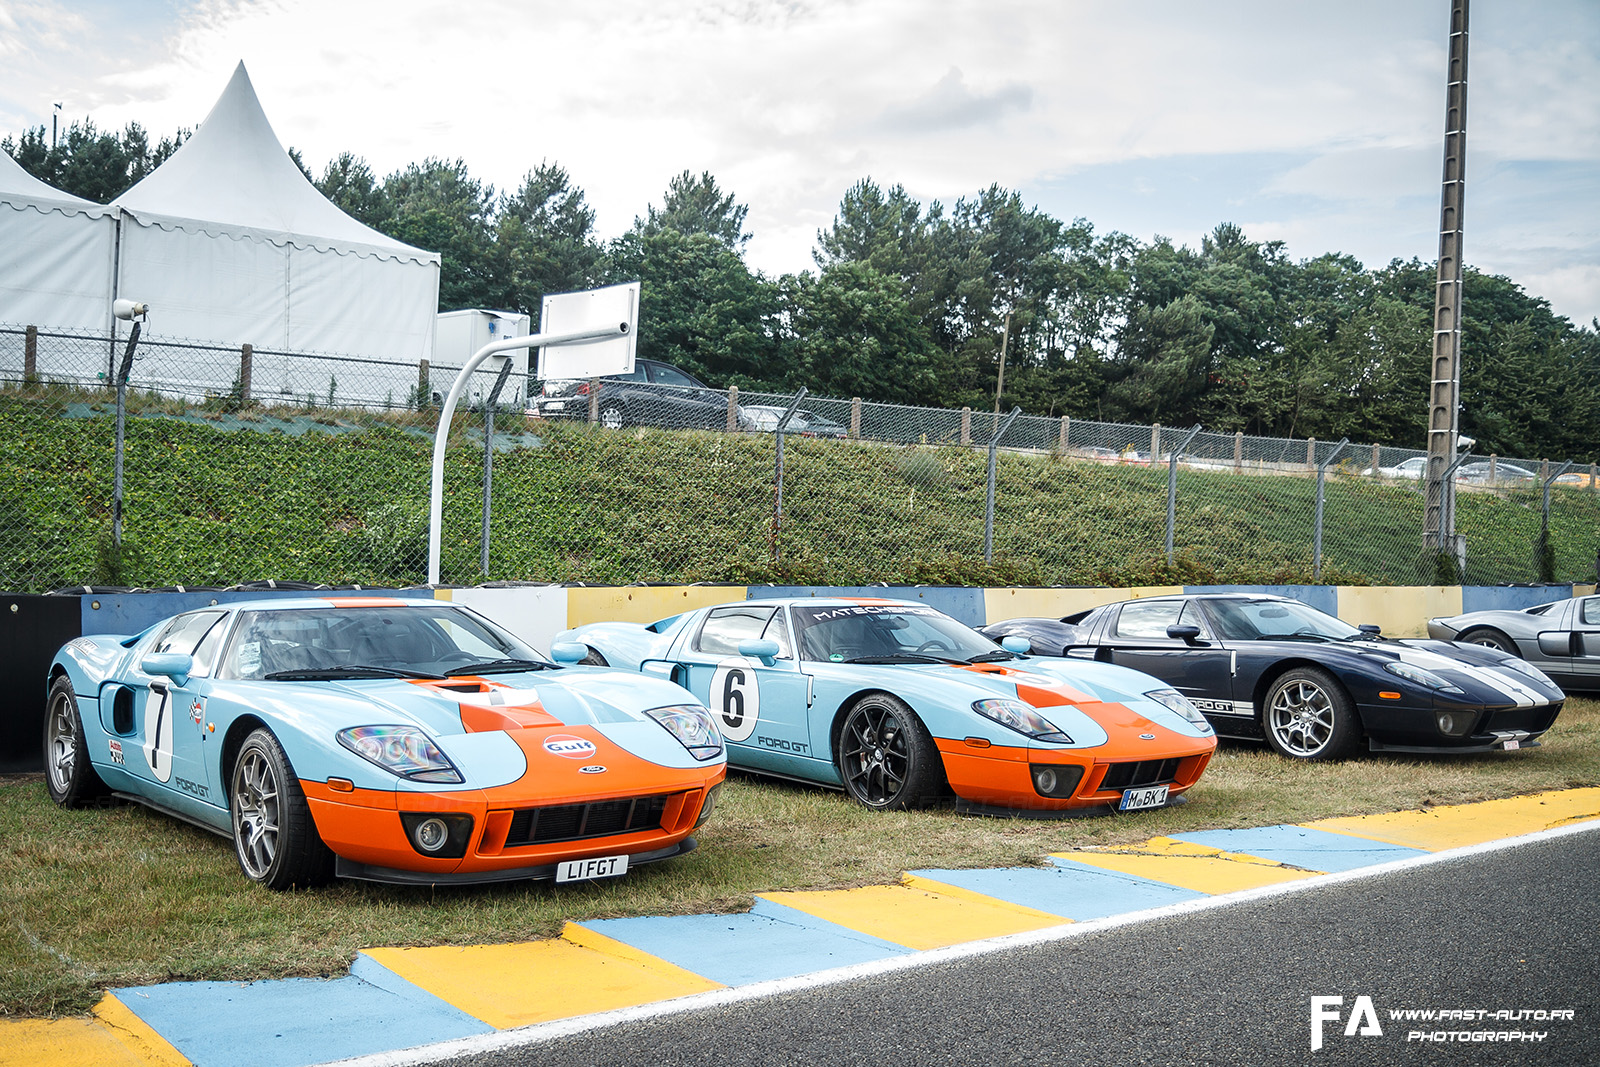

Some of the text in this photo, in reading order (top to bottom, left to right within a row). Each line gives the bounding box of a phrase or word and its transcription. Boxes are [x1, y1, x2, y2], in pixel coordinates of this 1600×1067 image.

[721, 669, 745, 728] 6
[150, 681, 168, 769] 7
[547, 741, 592, 752] Gulf
[758, 735, 808, 753] FORD GT
[175, 776, 198, 794] FORD
